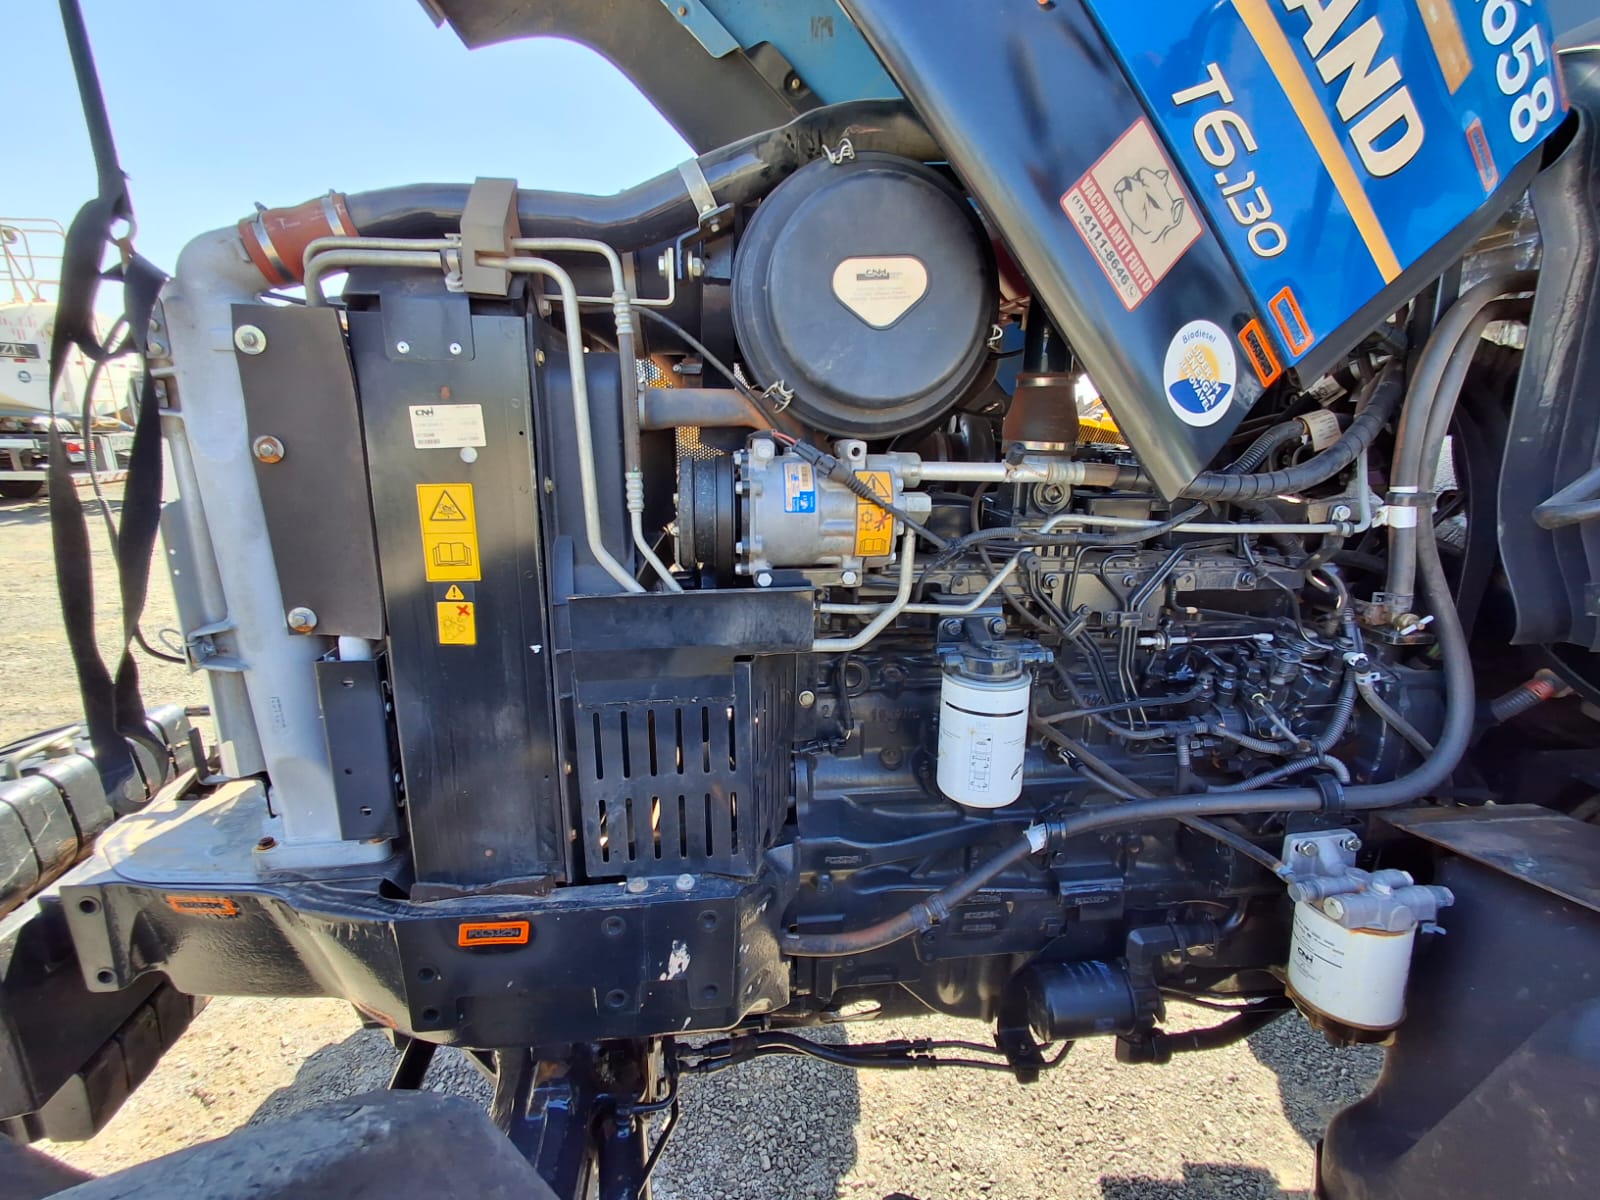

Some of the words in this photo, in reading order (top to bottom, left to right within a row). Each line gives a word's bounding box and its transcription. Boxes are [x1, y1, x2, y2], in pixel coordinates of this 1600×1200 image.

[1171, 62, 1288, 258] T6.130
[1080, 175, 1114, 226] VACINA
[1108, 221, 1132, 254] ANTI
[1125, 250, 1154, 293] FURTO
[1083, 214, 1130, 286] 4111-8646
[1182, 328, 1217, 345] Biodiesel
[1185, 350, 1217, 406] ENERGIA
